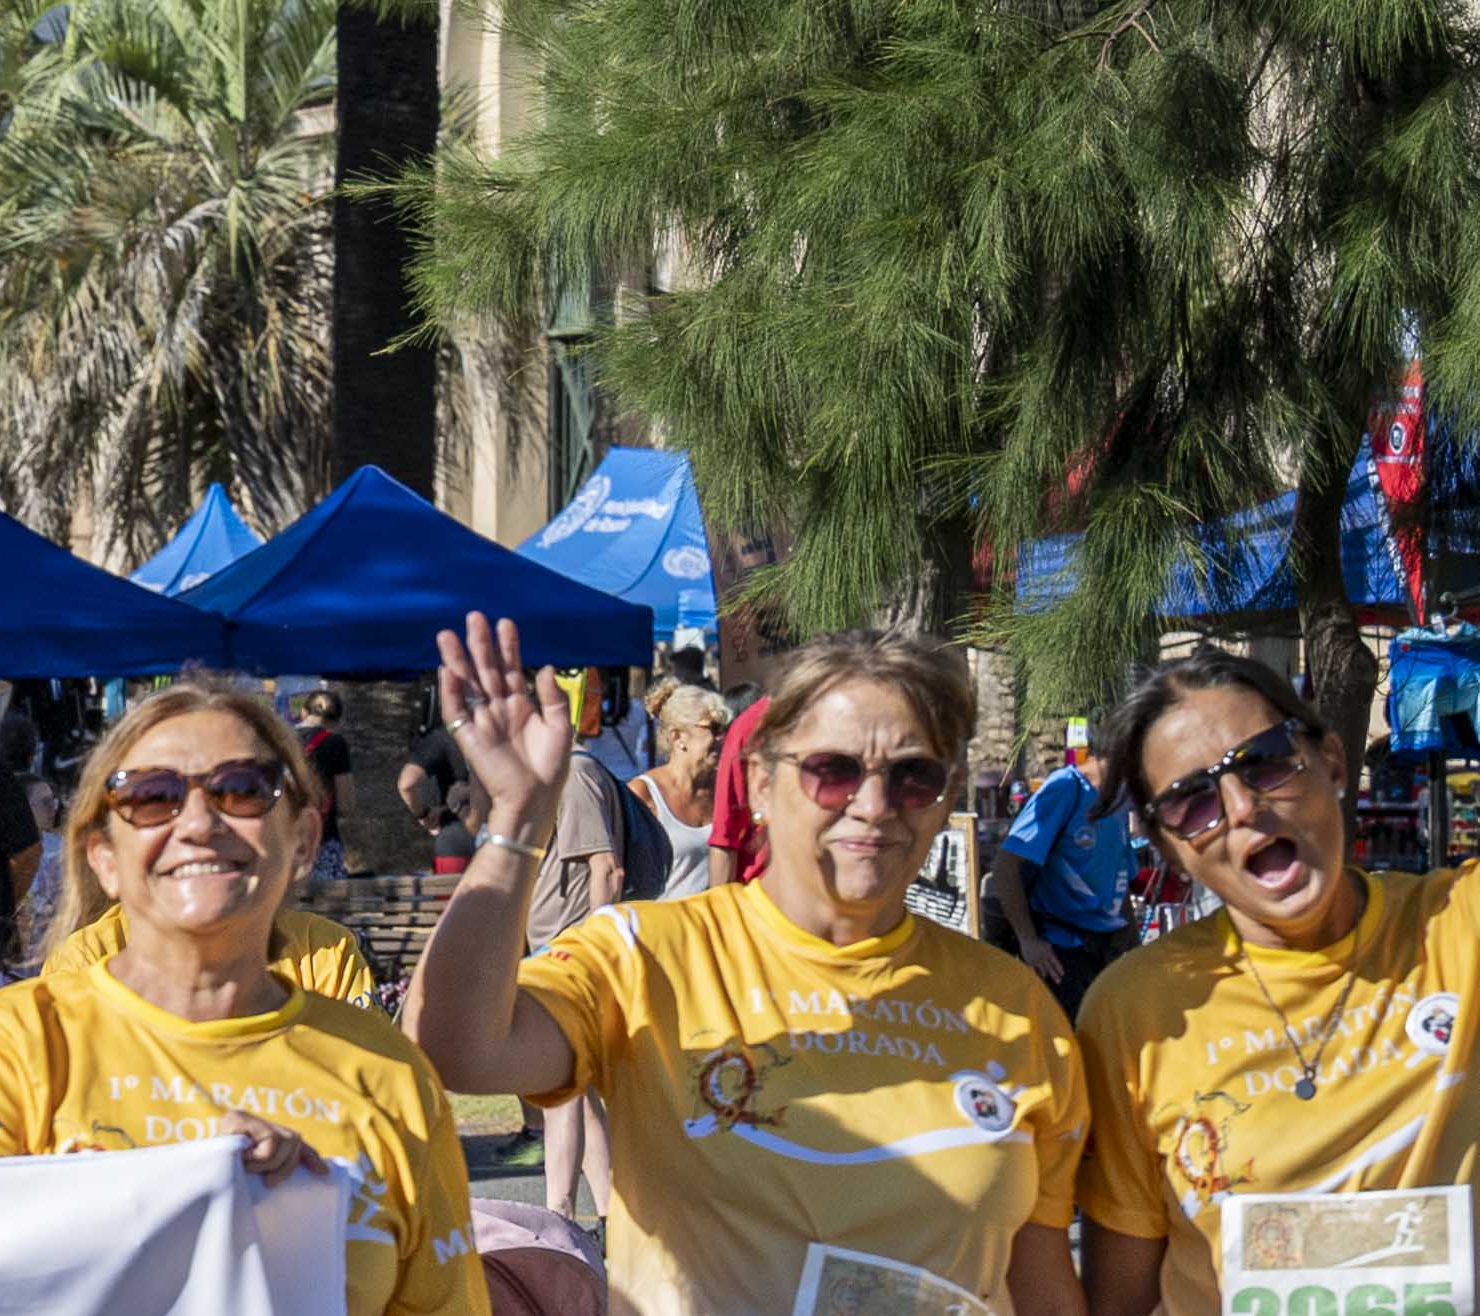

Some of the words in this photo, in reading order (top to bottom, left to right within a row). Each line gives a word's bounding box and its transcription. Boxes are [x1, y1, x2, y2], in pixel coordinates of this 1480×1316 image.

[789, 989, 968, 1034] MARATÓN
[789, 1030, 947, 1068] DORADA
[151, 1076, 341, 1125] MARATÓN
